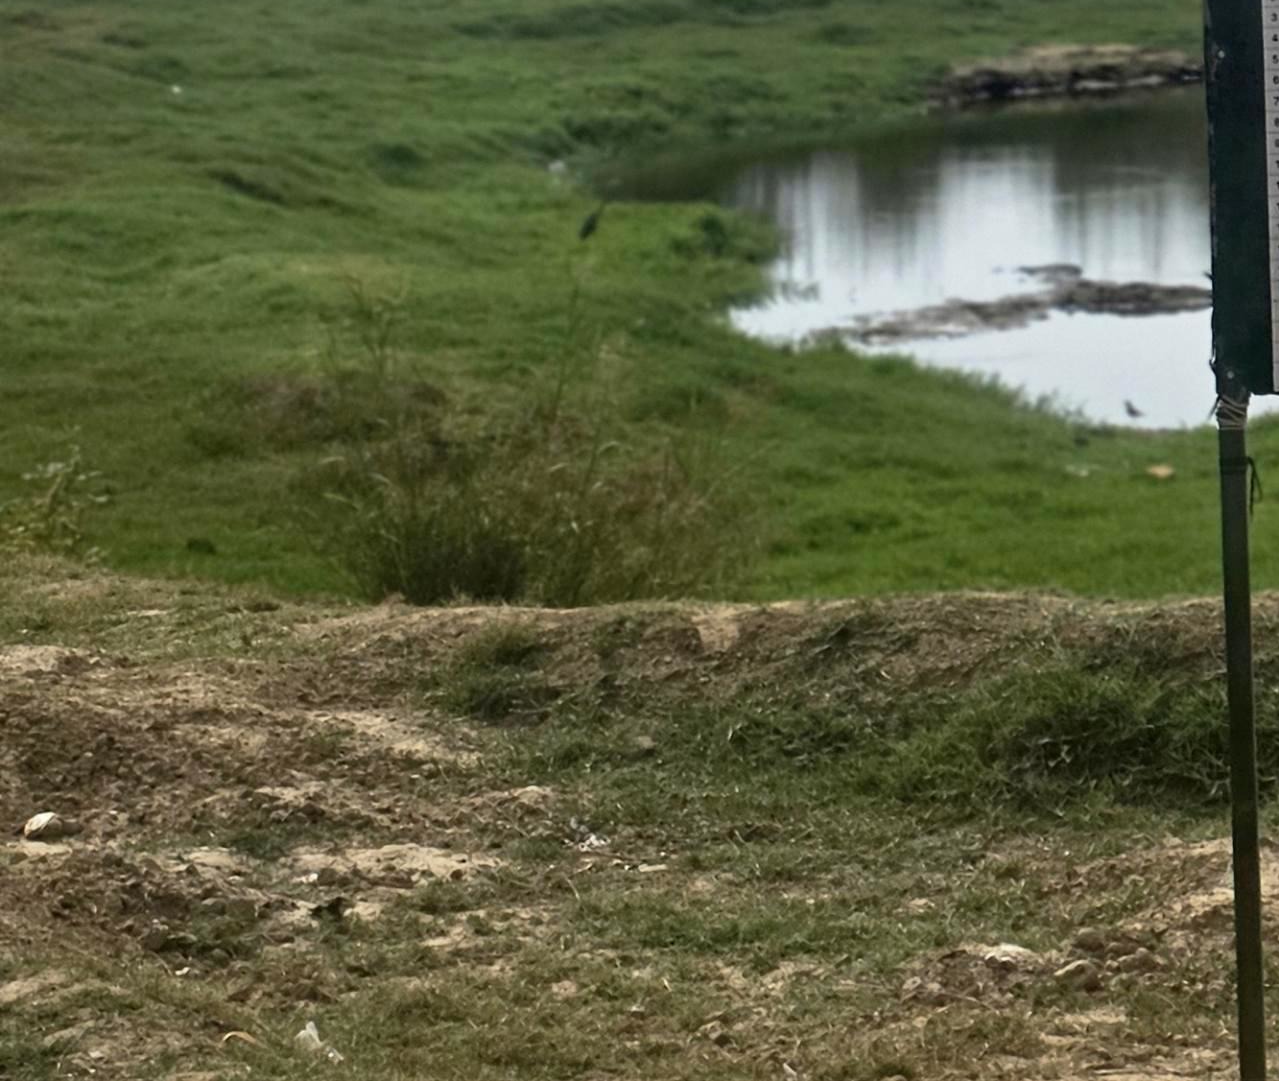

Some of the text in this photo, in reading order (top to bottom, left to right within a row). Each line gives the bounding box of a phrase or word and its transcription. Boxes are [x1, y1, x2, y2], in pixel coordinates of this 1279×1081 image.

[1271, 13, 1278, 21] 3
[1272, 34, 1278, 42] 4
[1272, 55, 1279, 63] 5
[1274, 97, 1279, 106] 7
